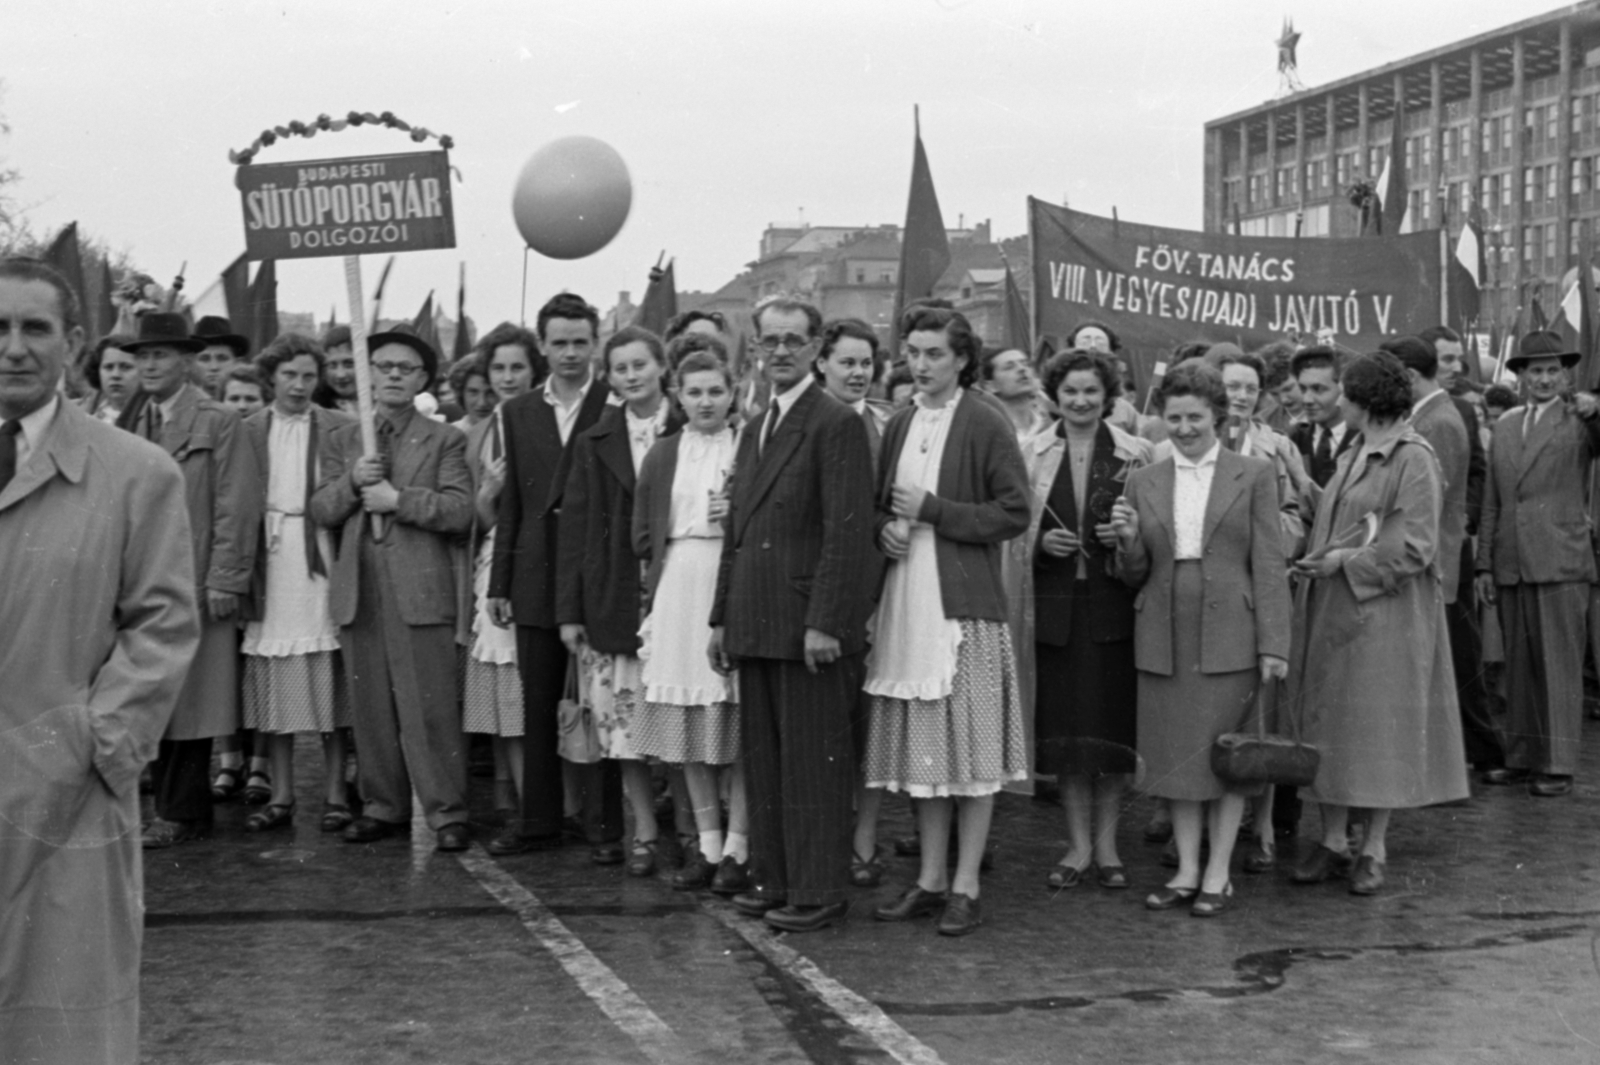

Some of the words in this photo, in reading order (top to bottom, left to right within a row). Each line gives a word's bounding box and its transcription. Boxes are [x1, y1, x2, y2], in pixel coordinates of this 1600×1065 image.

[297, 163, 386, 183] BUDAPESTI
[247, 173, 443, 230] SÜTŐPORGYÁR
[290, 223, 409, 249] DOLGOZÓI
[1135, 245, 1192, 275] FŐV.
[1198, 252, 1295, 283] TANÁCS
[1049, 261, 1089, 305] VIII.
[1095, 269, 1257, 328] VEGYESIPARI
[1268, 289, 1360, 335] JAVITÓ
[1373, 295, 1397, 335] V.
